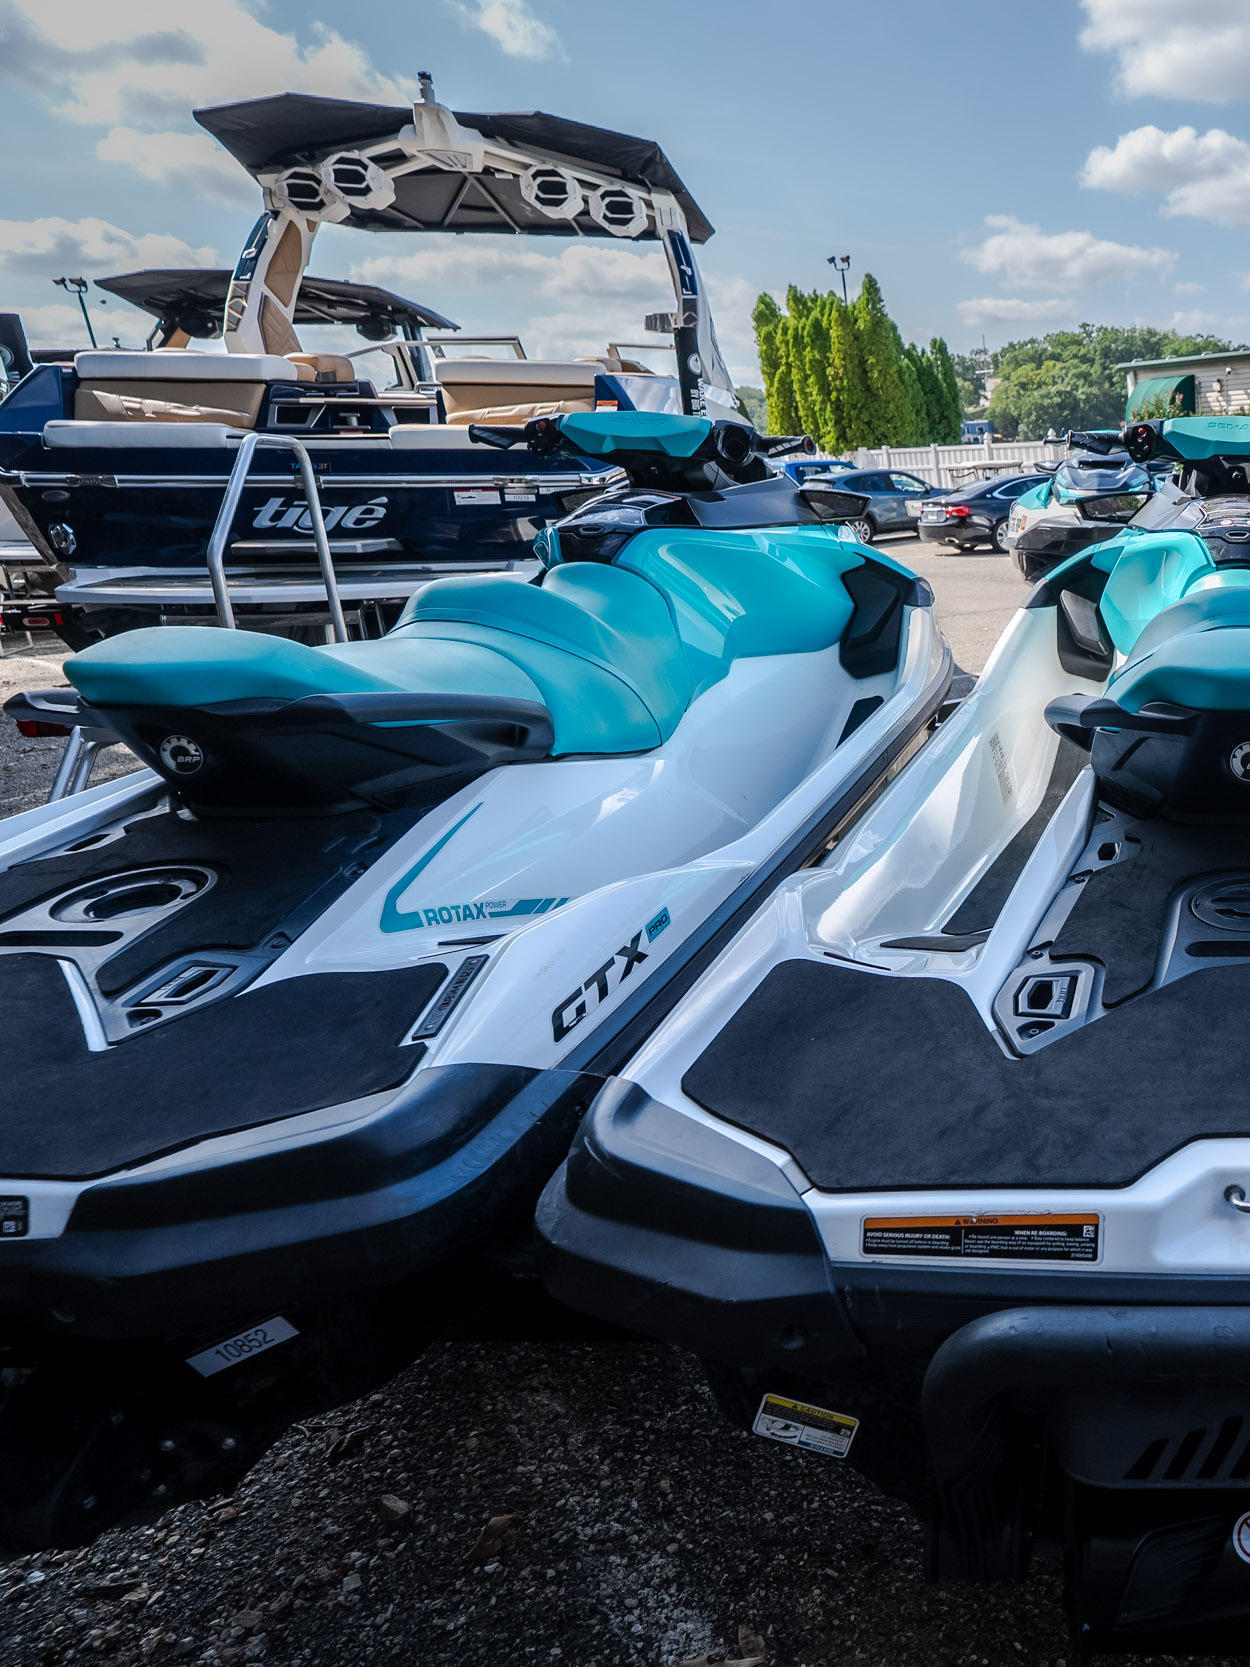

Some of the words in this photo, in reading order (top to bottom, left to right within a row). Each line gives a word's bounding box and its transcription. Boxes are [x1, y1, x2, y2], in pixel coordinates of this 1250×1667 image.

[252, 496, 389, 534] tigé
[176, 755, 201, 764] BRP
[423, 903, 487, 926] ROTAX
[485, 900, 507, 910] POWER
[552, 930, 649, 1043] GTX
[647, 913, 668, 938] PRO
[215, 1328, 275, 1362] 10852
